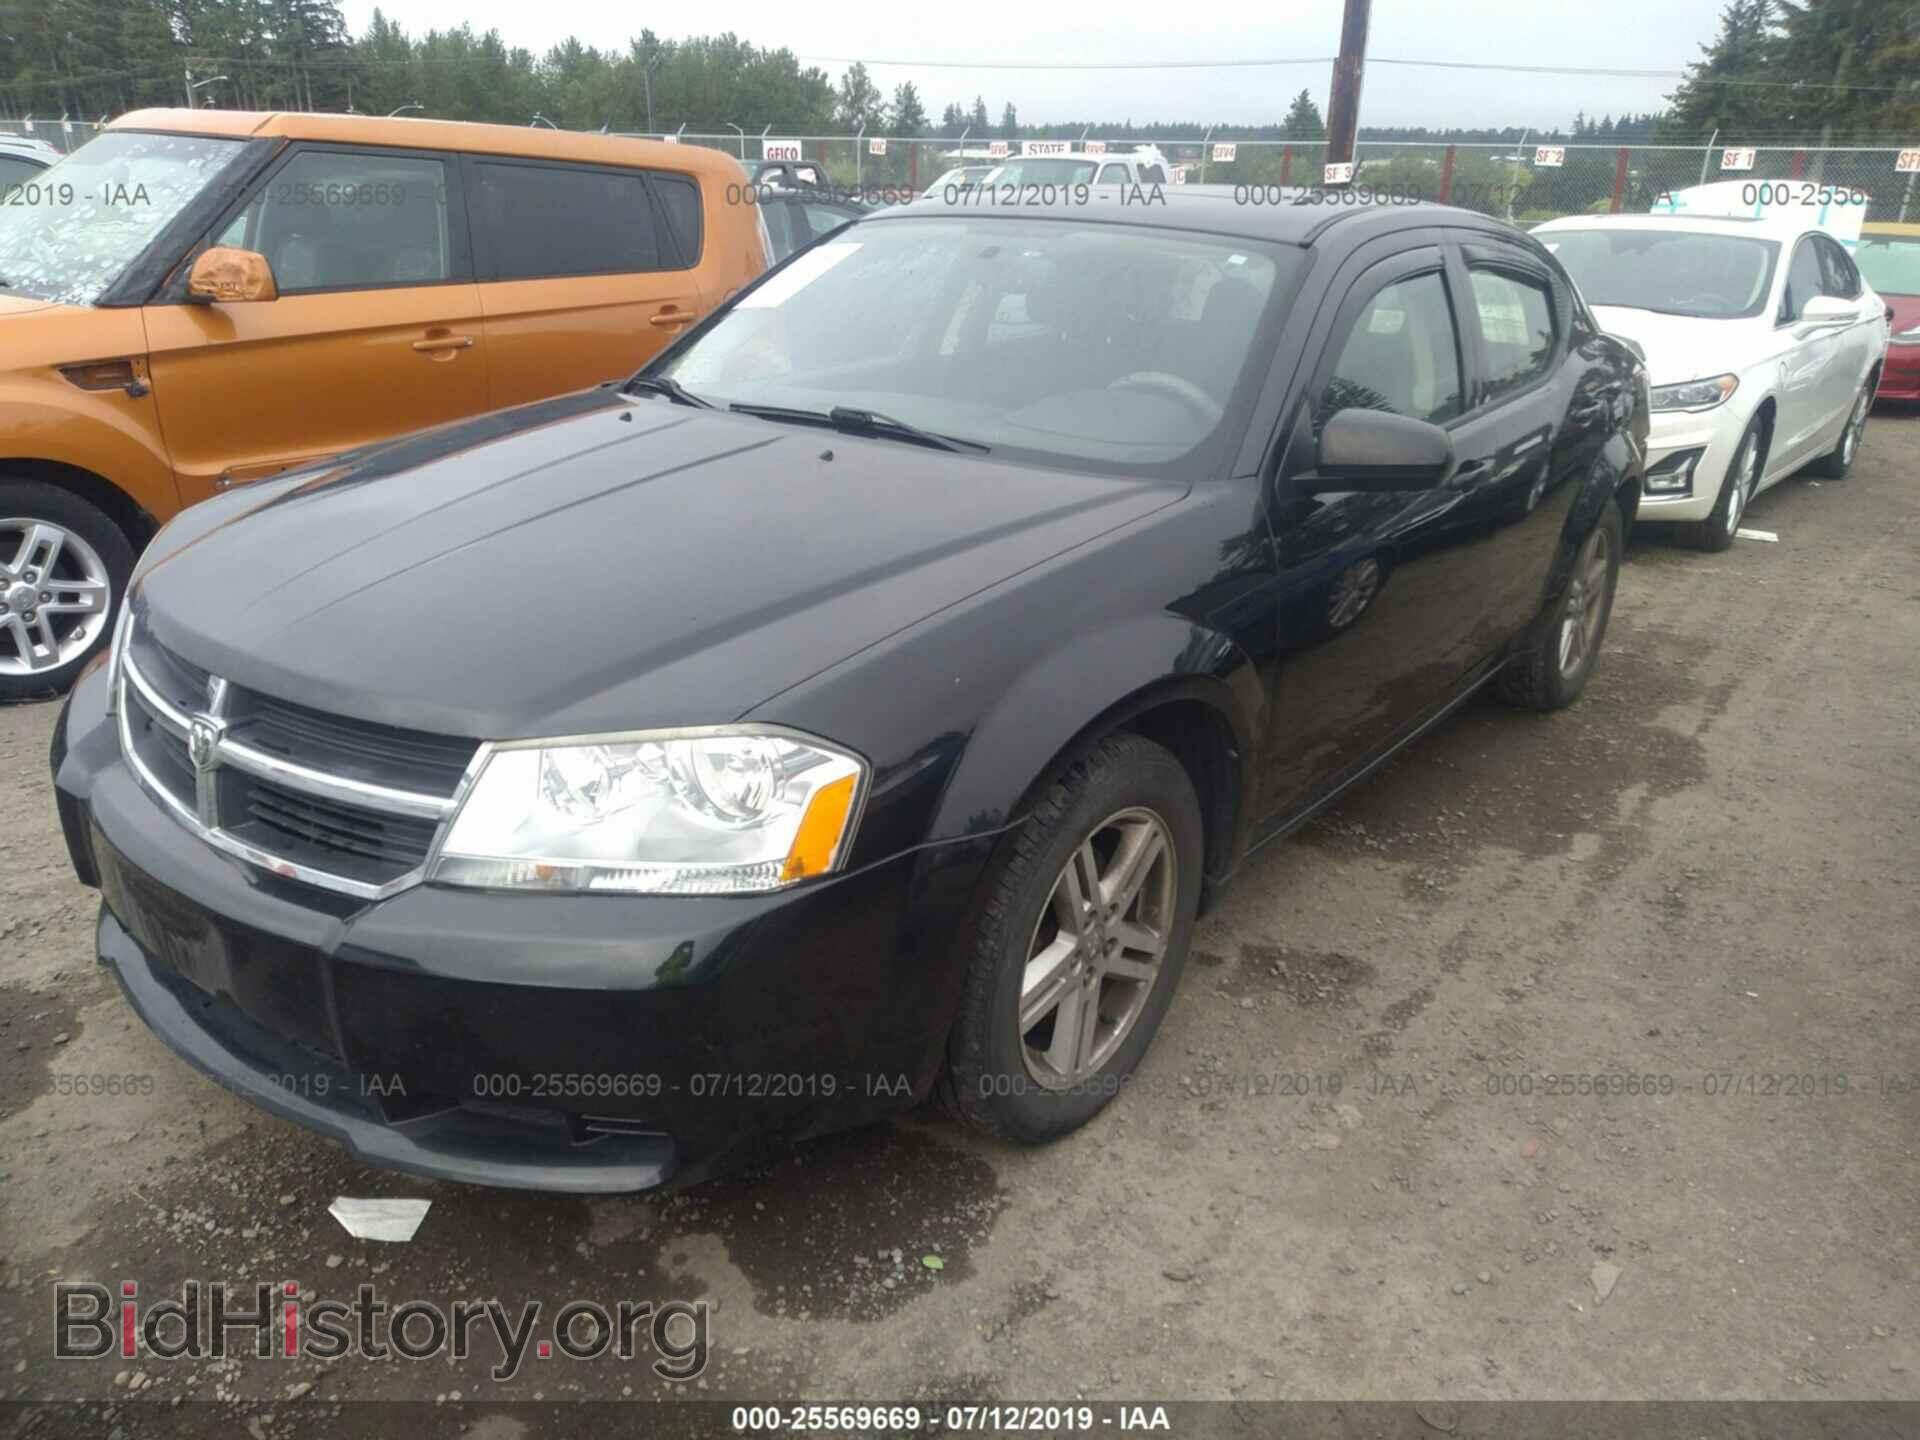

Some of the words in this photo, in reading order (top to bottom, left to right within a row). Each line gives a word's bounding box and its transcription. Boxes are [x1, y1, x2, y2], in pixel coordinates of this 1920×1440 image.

[767, 147, 799, 160] GEICO
[1028, 143, 1065, 156] STATE
[1723, 151, 1739, 167] SF
